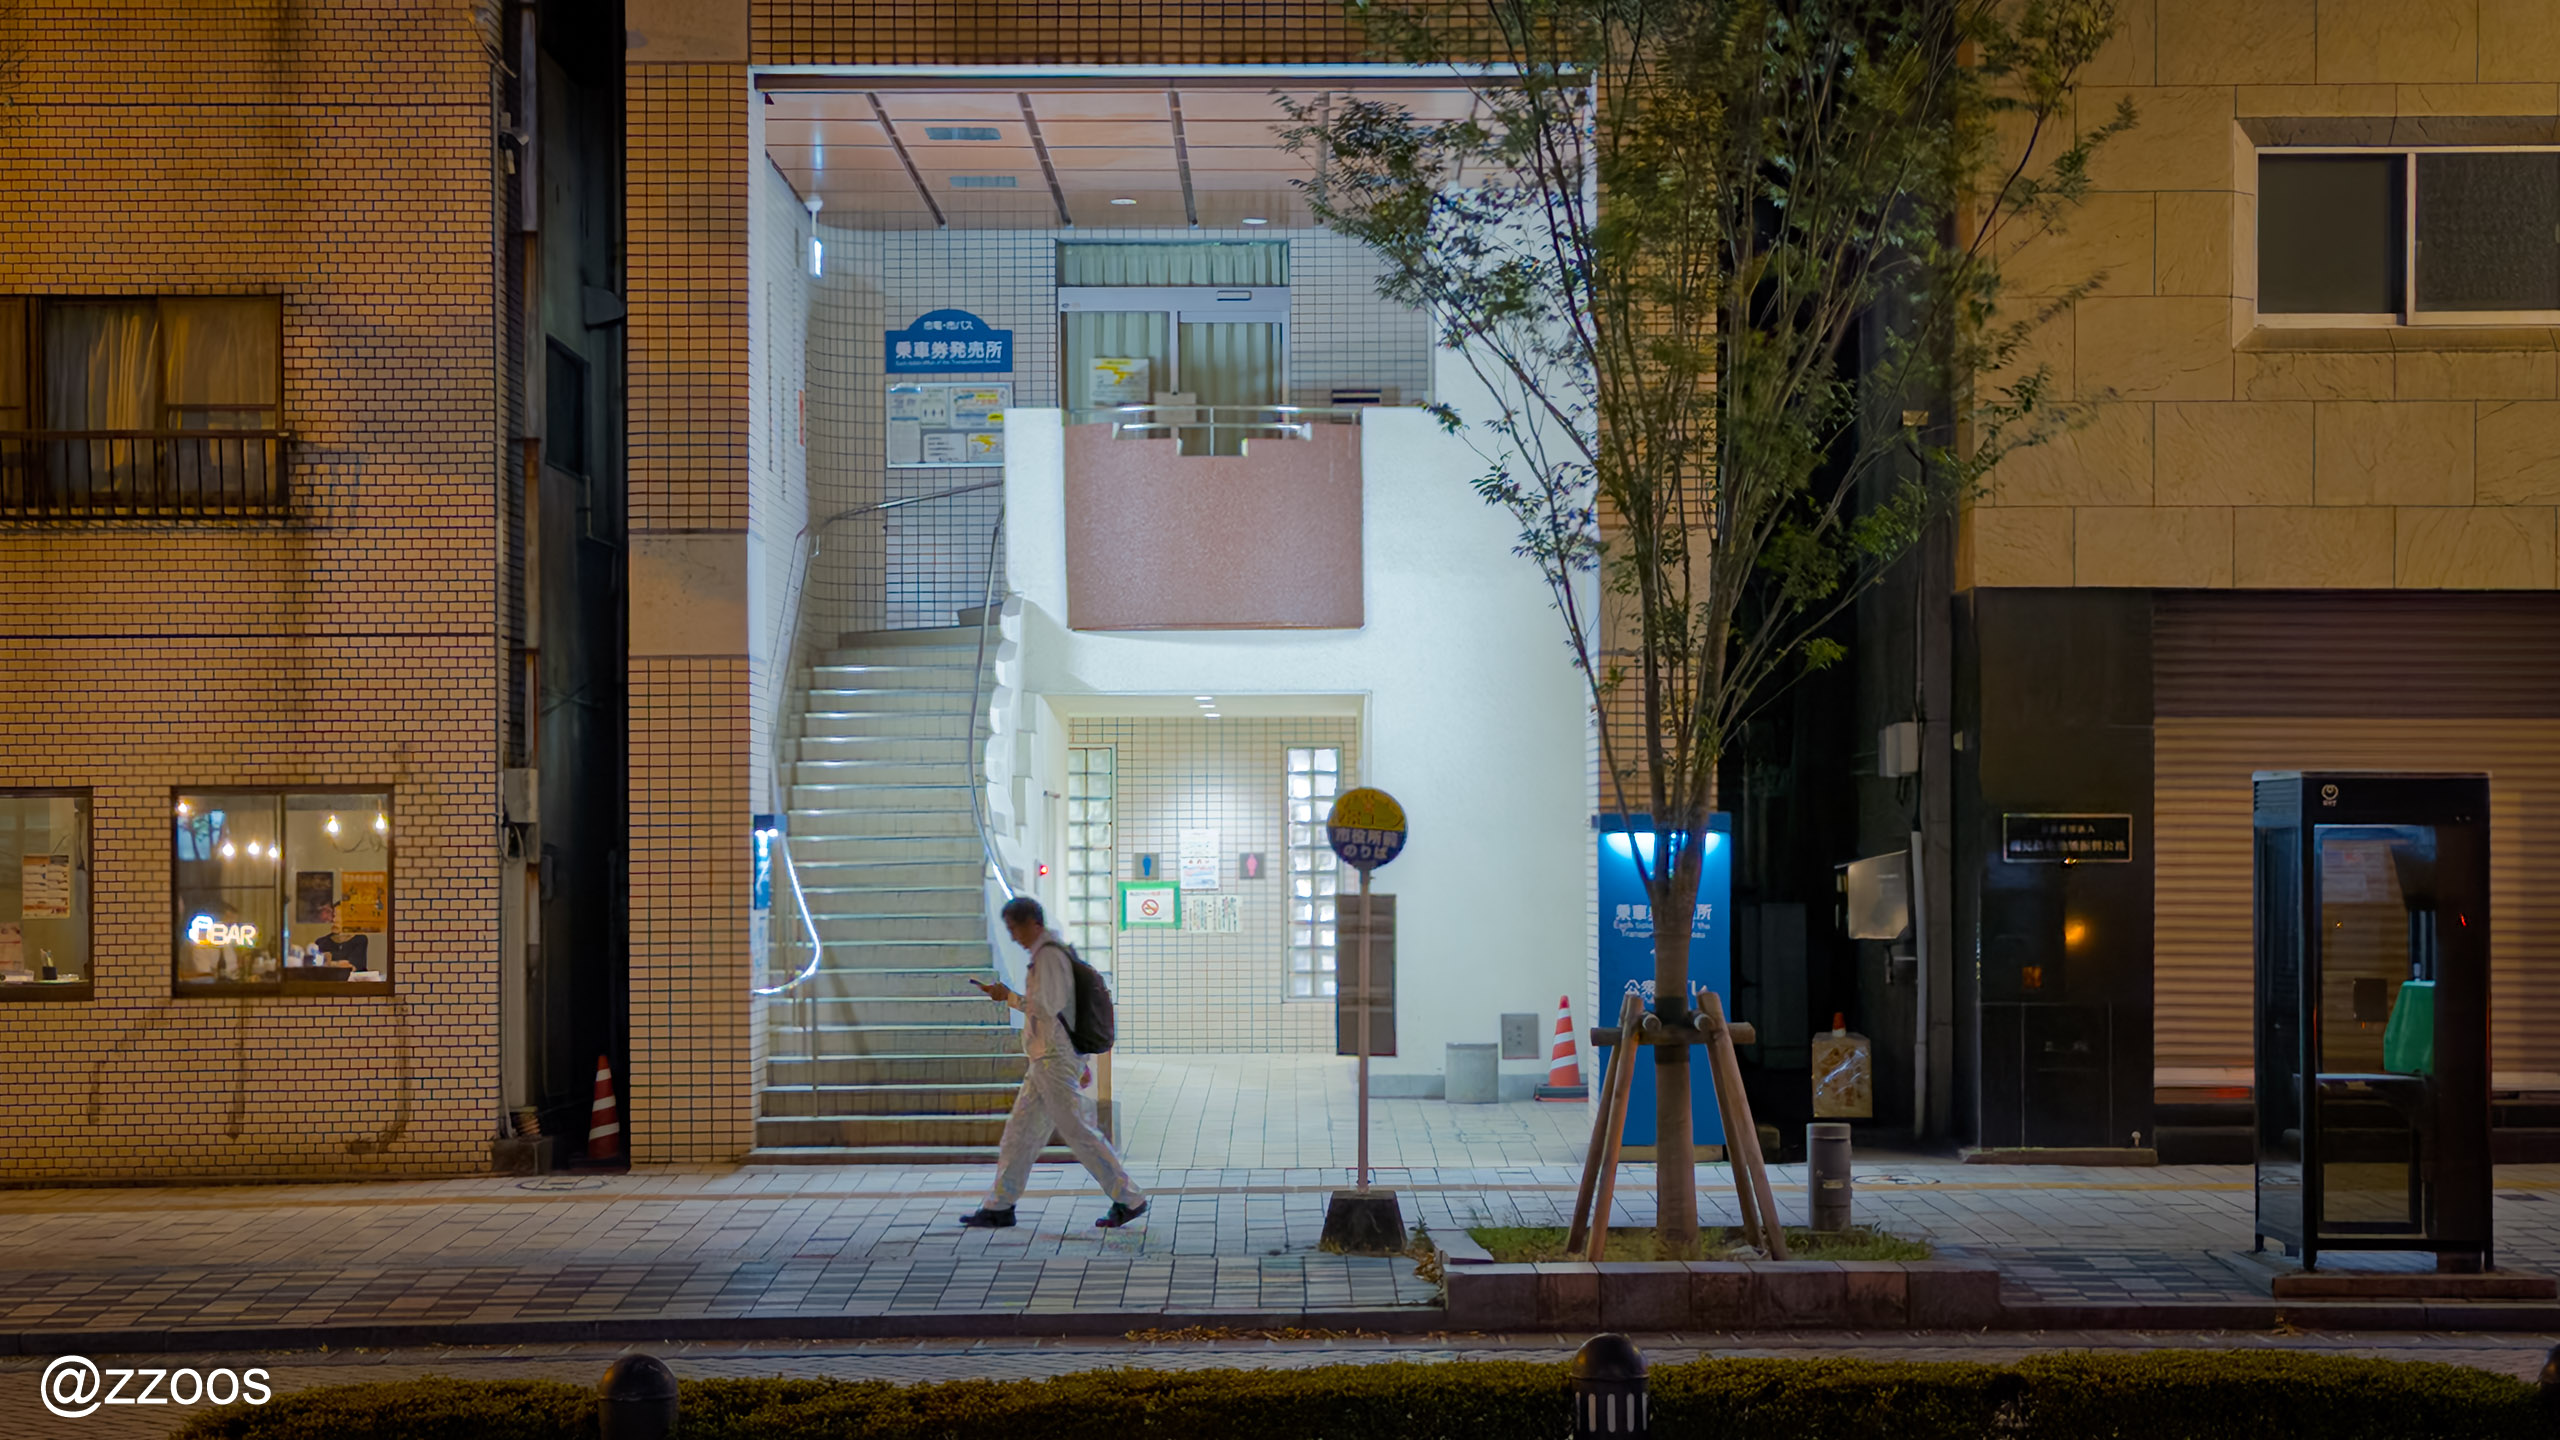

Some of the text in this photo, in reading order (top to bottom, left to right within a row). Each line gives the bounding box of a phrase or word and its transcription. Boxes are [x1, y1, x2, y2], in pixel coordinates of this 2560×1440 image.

[895, 341, 1002, 359] 乗車券発売所
[1335, 827, 1398, 849] 市役所前
[1343, 844, 1388, 859] のりば
[211, 923, 257, 947] BAR
